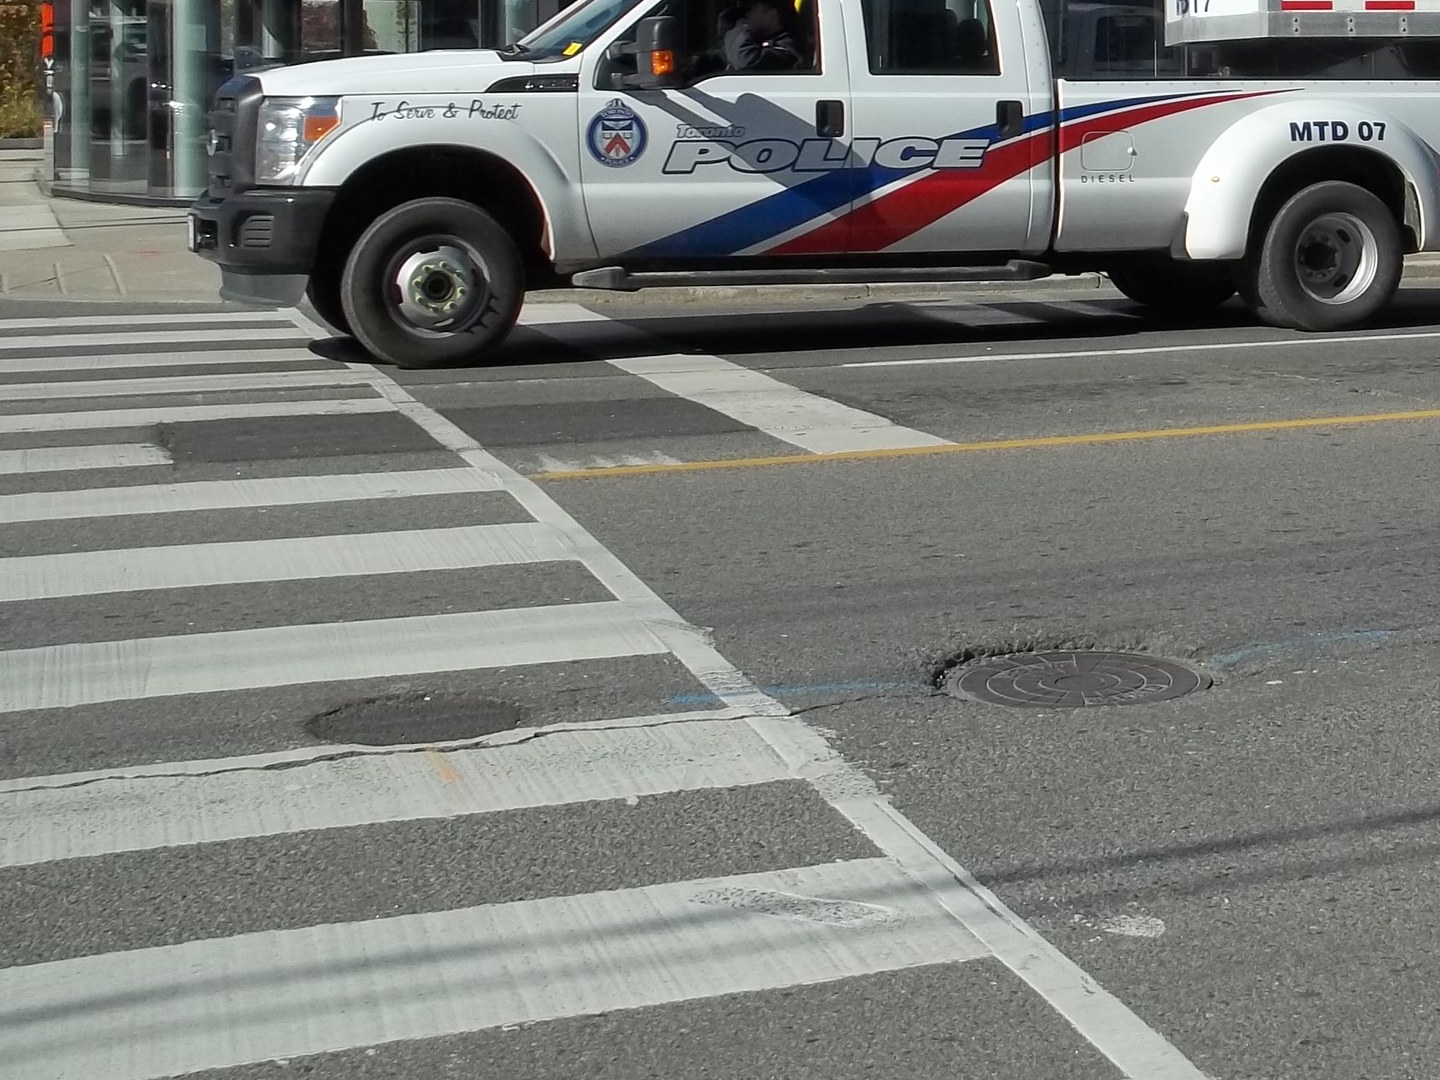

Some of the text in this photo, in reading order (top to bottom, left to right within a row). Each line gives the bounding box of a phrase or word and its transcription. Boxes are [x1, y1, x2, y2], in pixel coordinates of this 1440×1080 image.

[370, 99, 522, 121] To Serve & Protect
[676, 123, 746, 139] Toronto
[1289, 121, 1386, 142] MTD 07
[661, 136, 991, 175] POLICE
[1080, 174, 1135, 184] DIESEL
